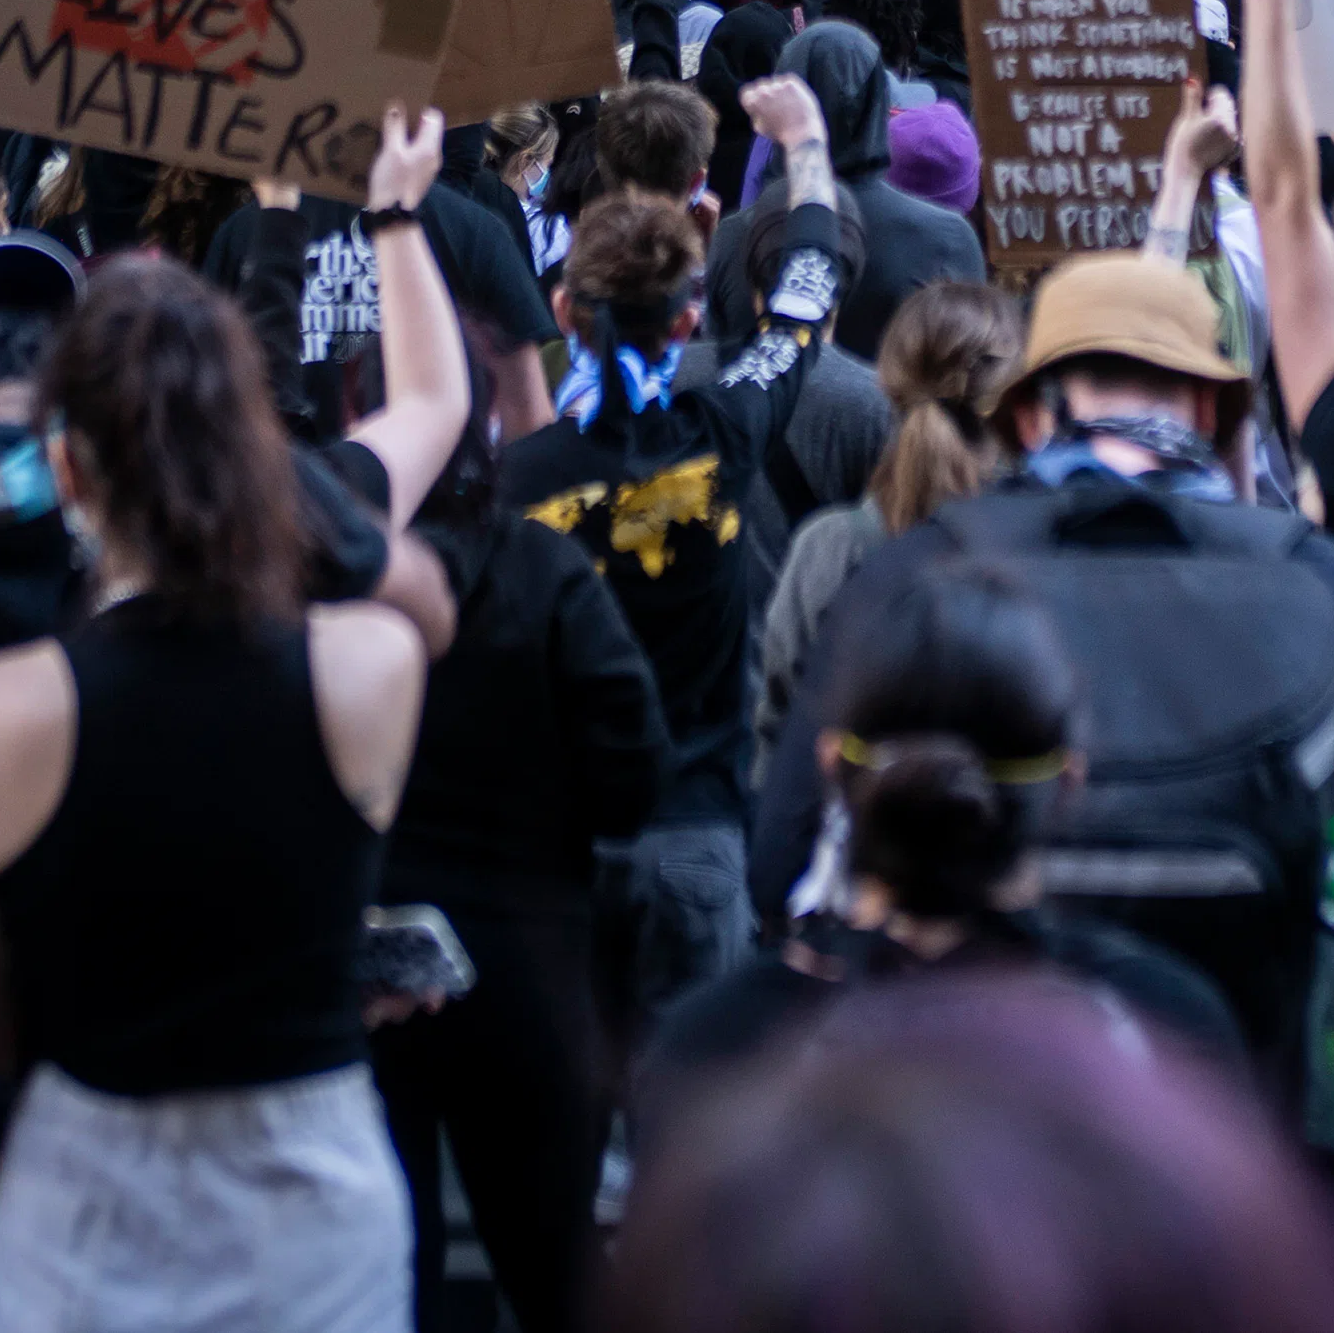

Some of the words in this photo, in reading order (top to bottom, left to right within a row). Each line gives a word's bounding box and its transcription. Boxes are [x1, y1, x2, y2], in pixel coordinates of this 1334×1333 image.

[982, 22, 1068, 50] THINK
[1075, 19, 1197, 50] SOMETHING
[994, 55, 1018, 81] IS
[1029, 122, 1094, 157] NOT
[1097, 123, 1124, 154] A
[992, 161, 1136, 201] PROBLEM
[985, 206, 1046, 250] YOU
